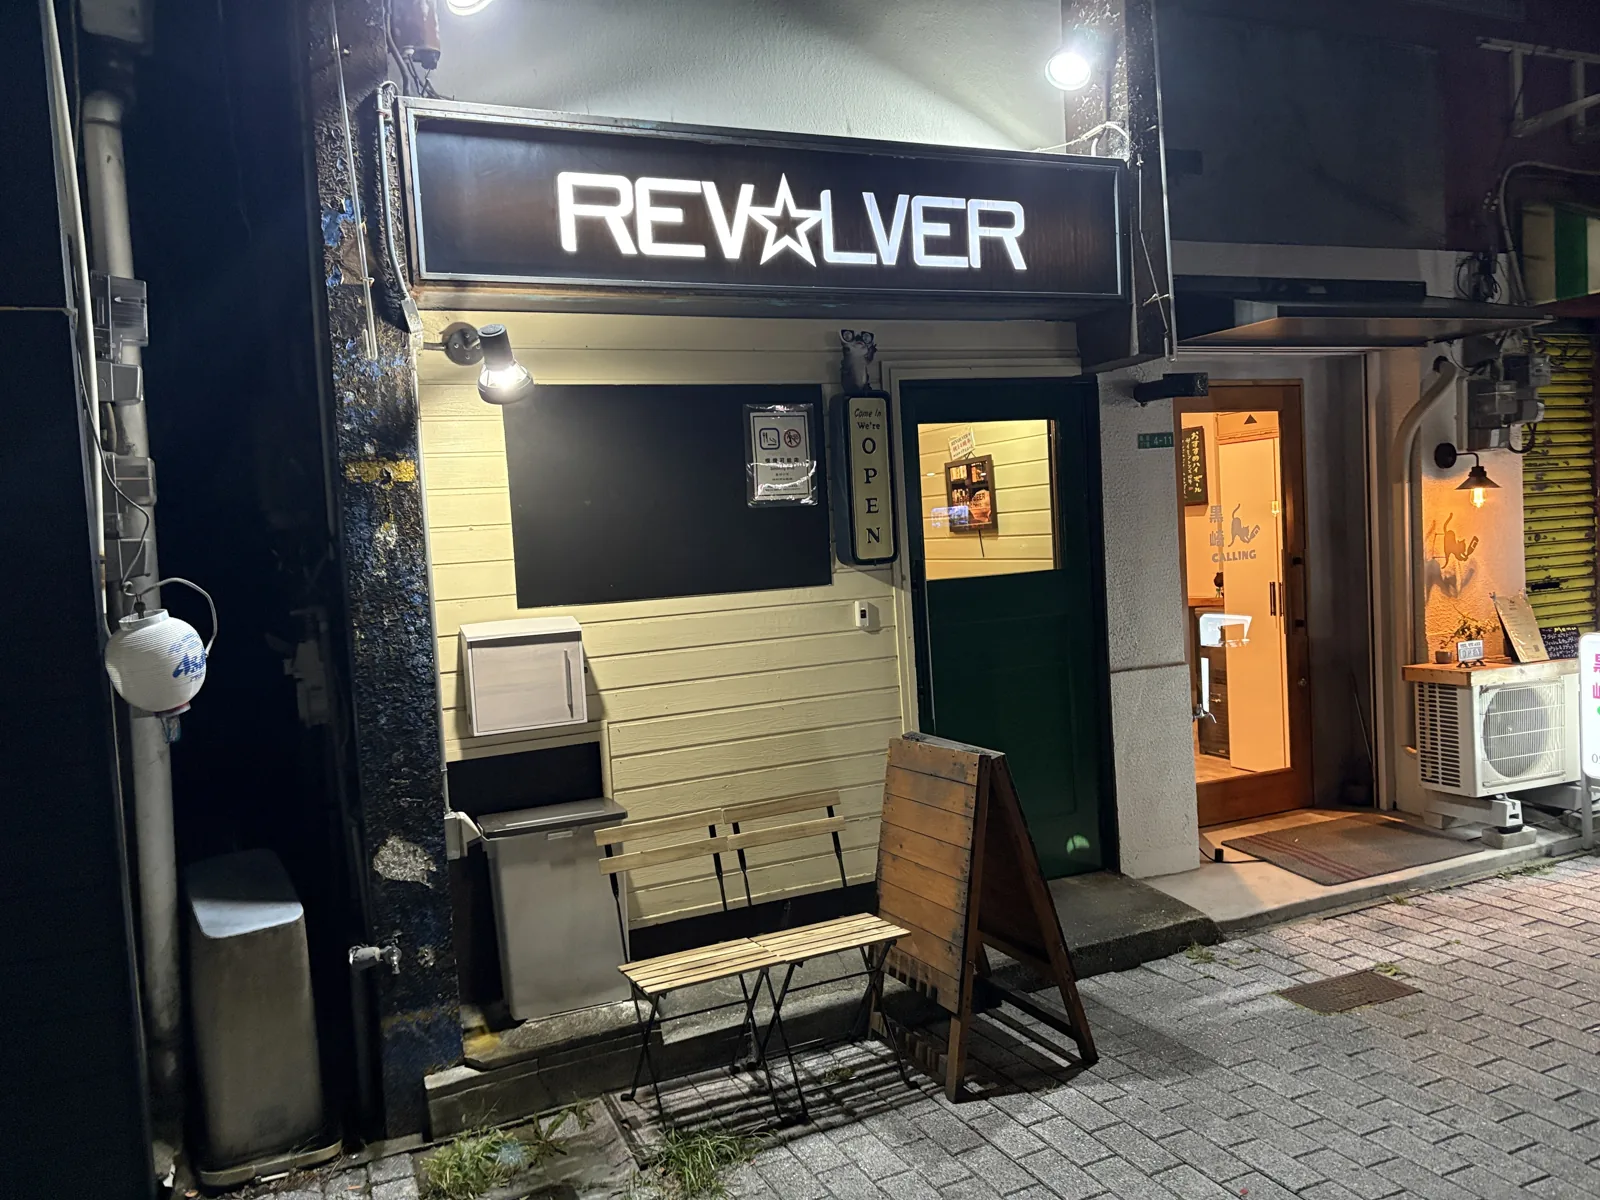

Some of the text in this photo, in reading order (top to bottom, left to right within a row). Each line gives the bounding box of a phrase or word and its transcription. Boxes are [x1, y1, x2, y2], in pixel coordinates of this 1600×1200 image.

[854, 408, 872, 418] Come
[857, 421, 881, 430] We're
[1153, 436, 1172, 446] 4-11
[862, 437, 881, 544] OPEN
[1211, 549, 1257, 563] CALLING
